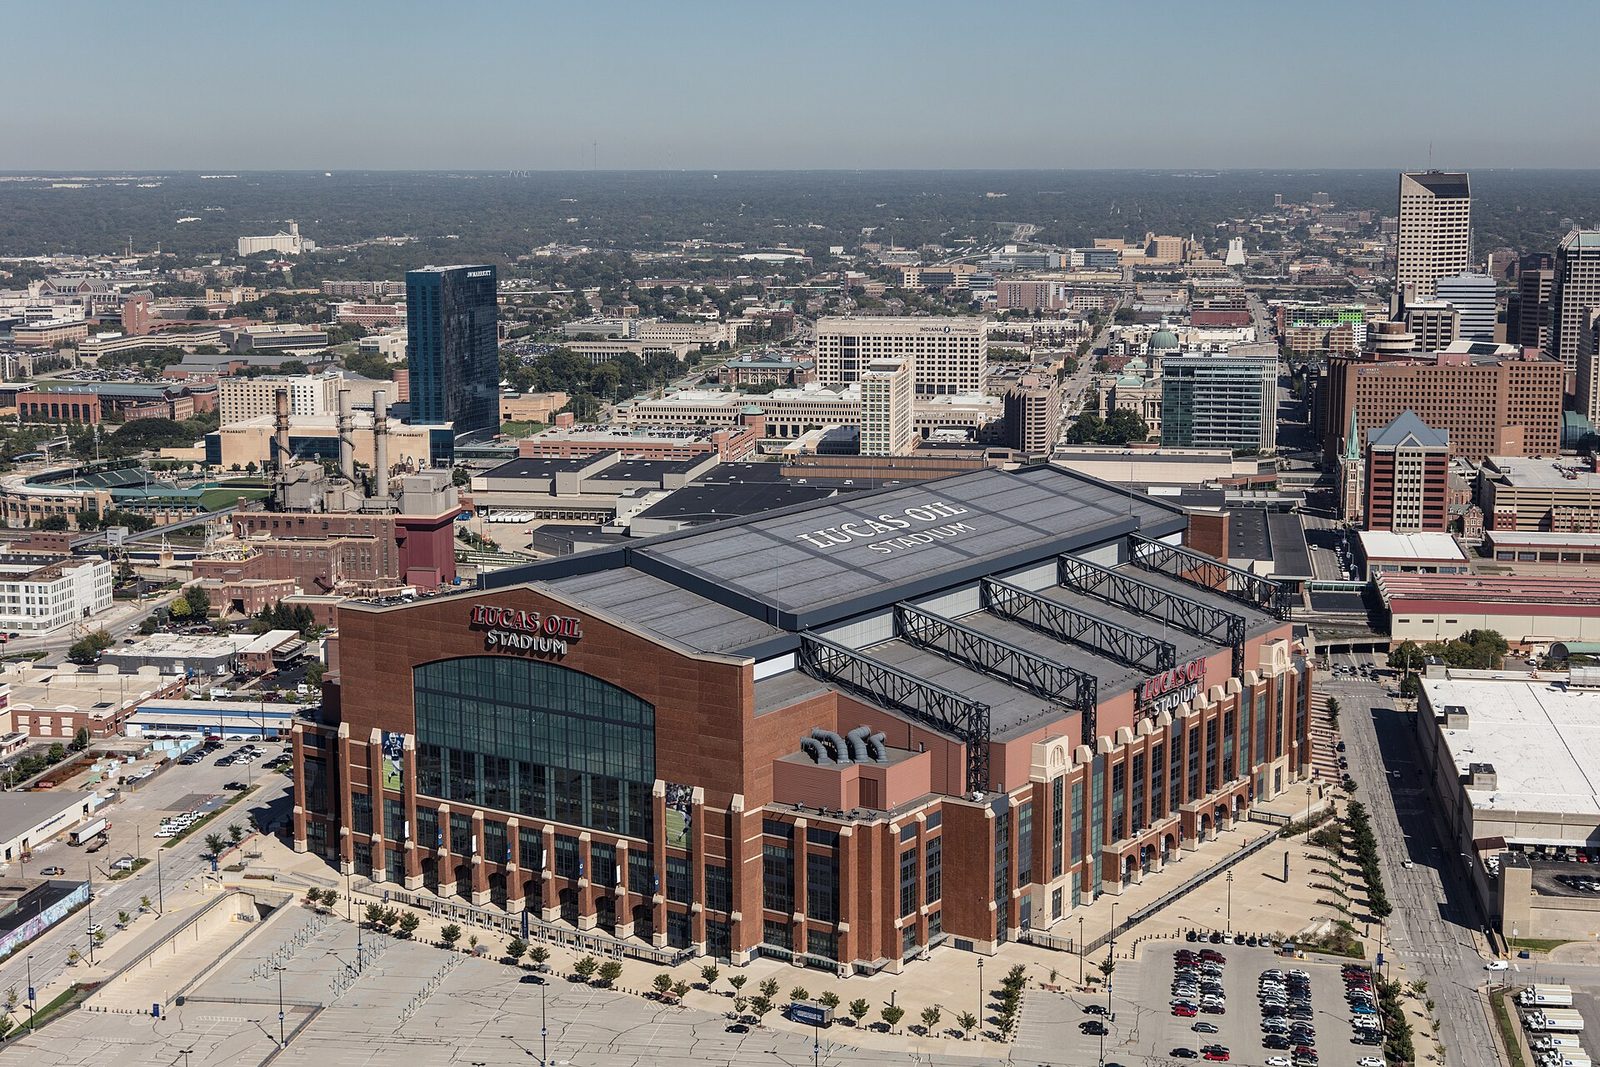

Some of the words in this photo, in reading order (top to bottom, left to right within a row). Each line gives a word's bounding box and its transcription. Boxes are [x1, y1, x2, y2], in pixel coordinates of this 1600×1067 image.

[796, 514, 911, 549] LUCAS
[904, 501, 968, 521] OIL
[866, 522, 977, 554] STADIUM
[471, 604, 541, 633] LUCAS
[543, 614, 583, 639] OIL
[487, 629, 568, 655] STADIUM
[1142, 664, 1186, 700] LUCAS
[1186, 656, 1207, 682] OIL
[1153, 683, 1198, 716] STADIUM
